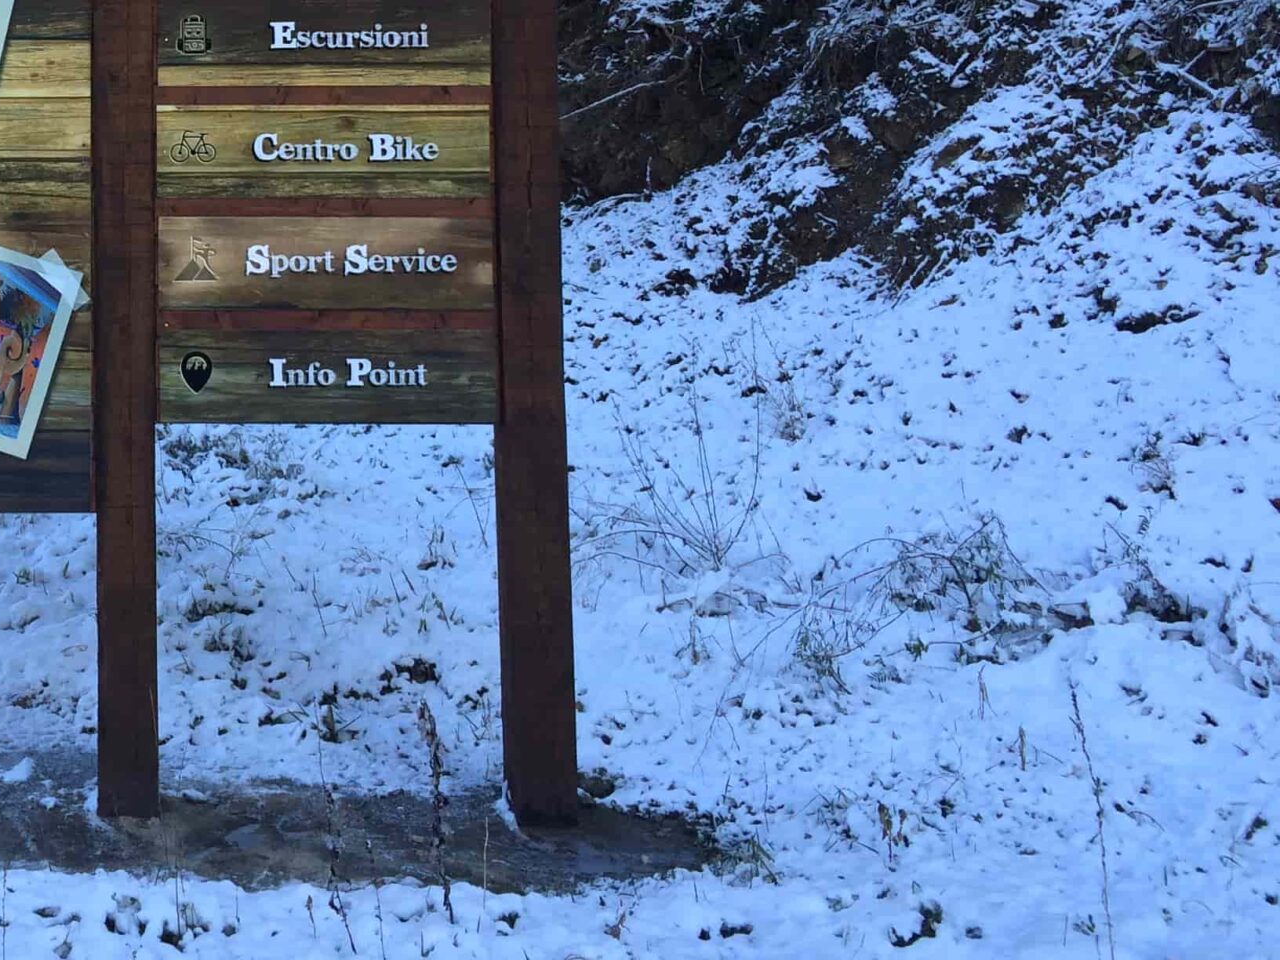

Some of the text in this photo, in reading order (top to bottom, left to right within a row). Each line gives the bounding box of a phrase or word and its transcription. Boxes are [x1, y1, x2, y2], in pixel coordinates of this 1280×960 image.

[270, 21, 429, 50] Escursioni
[253, 133, 439, 161] Centro Bike
[245, 244, 458, 278] Sport Service
[269, 358, 428, 387] Info Point
